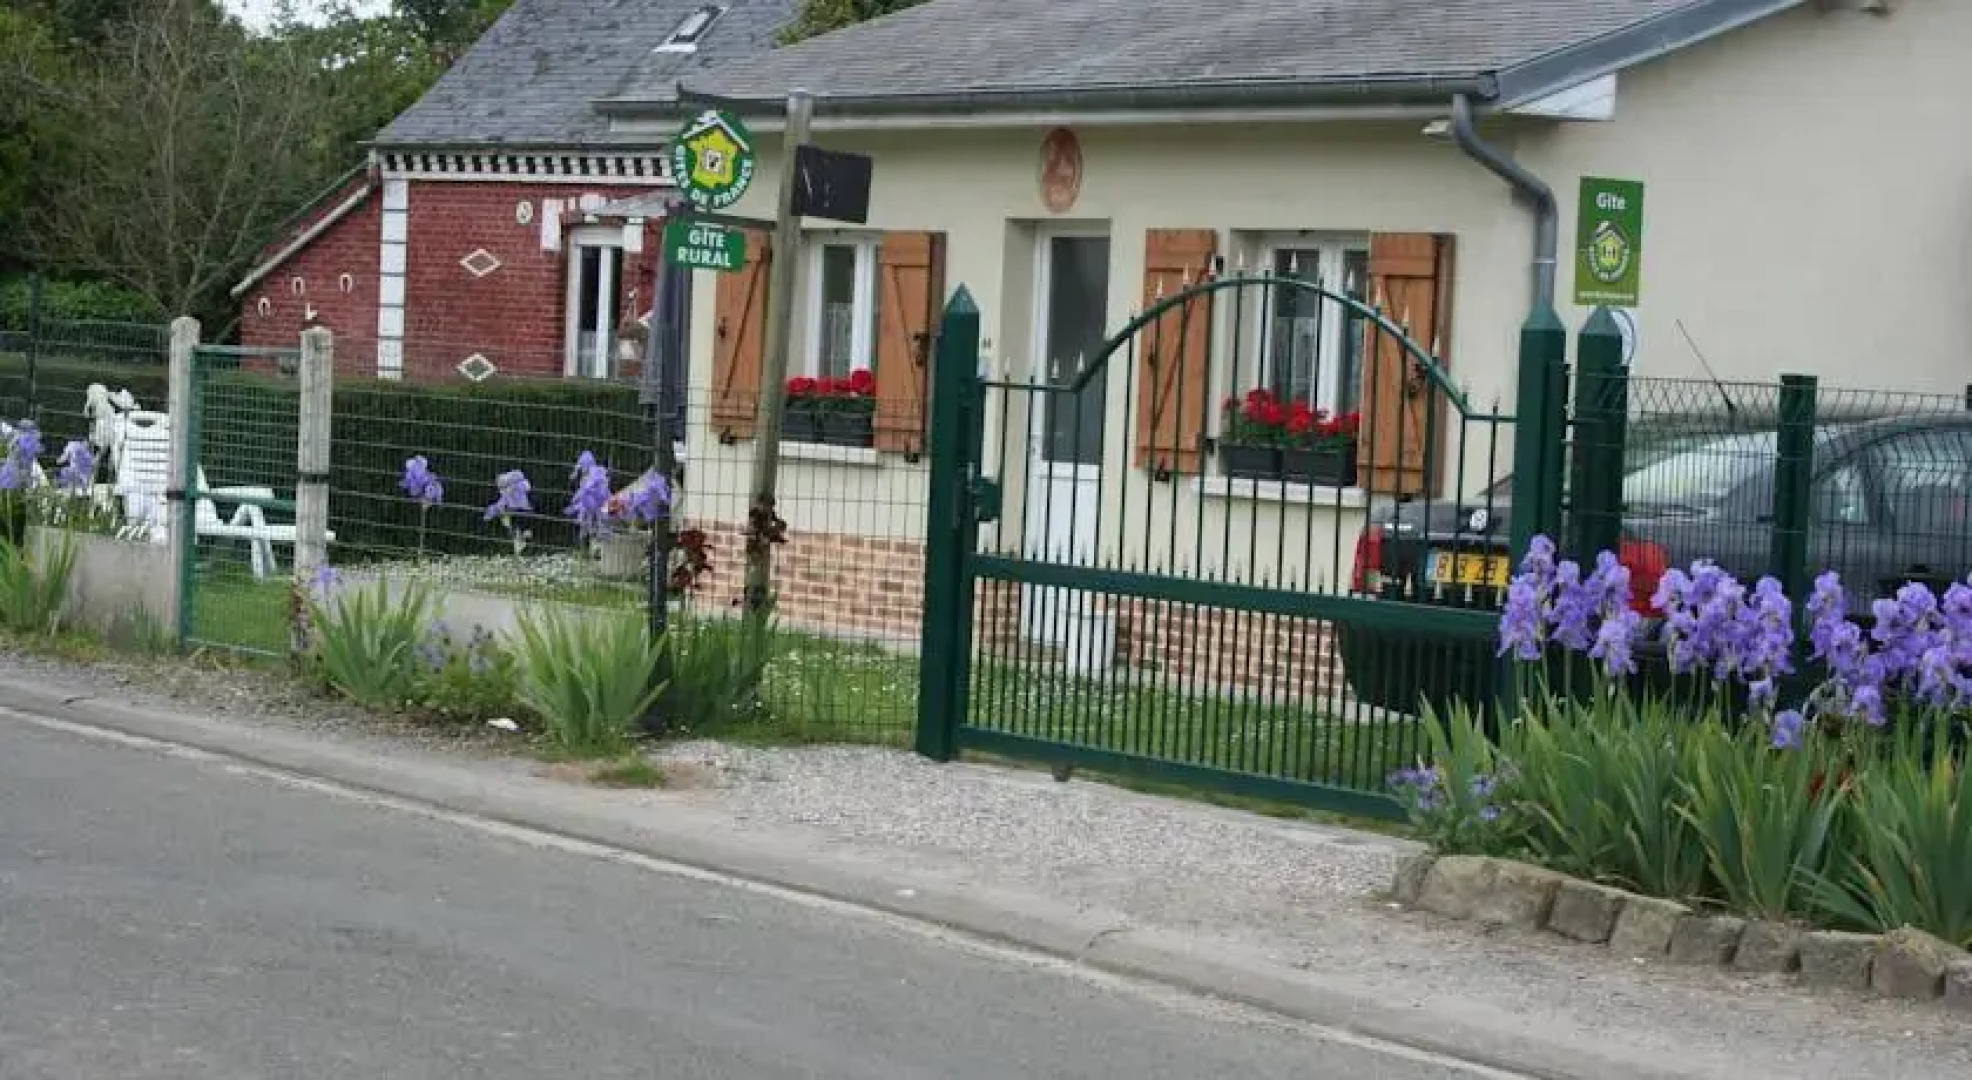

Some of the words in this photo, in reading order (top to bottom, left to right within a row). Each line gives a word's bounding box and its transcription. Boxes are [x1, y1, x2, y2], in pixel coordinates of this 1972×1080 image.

[690, 187, 709, 206] DE
[713, 158, 752, 207] FRANCE
[677, 245, 731, 268] RURAL
